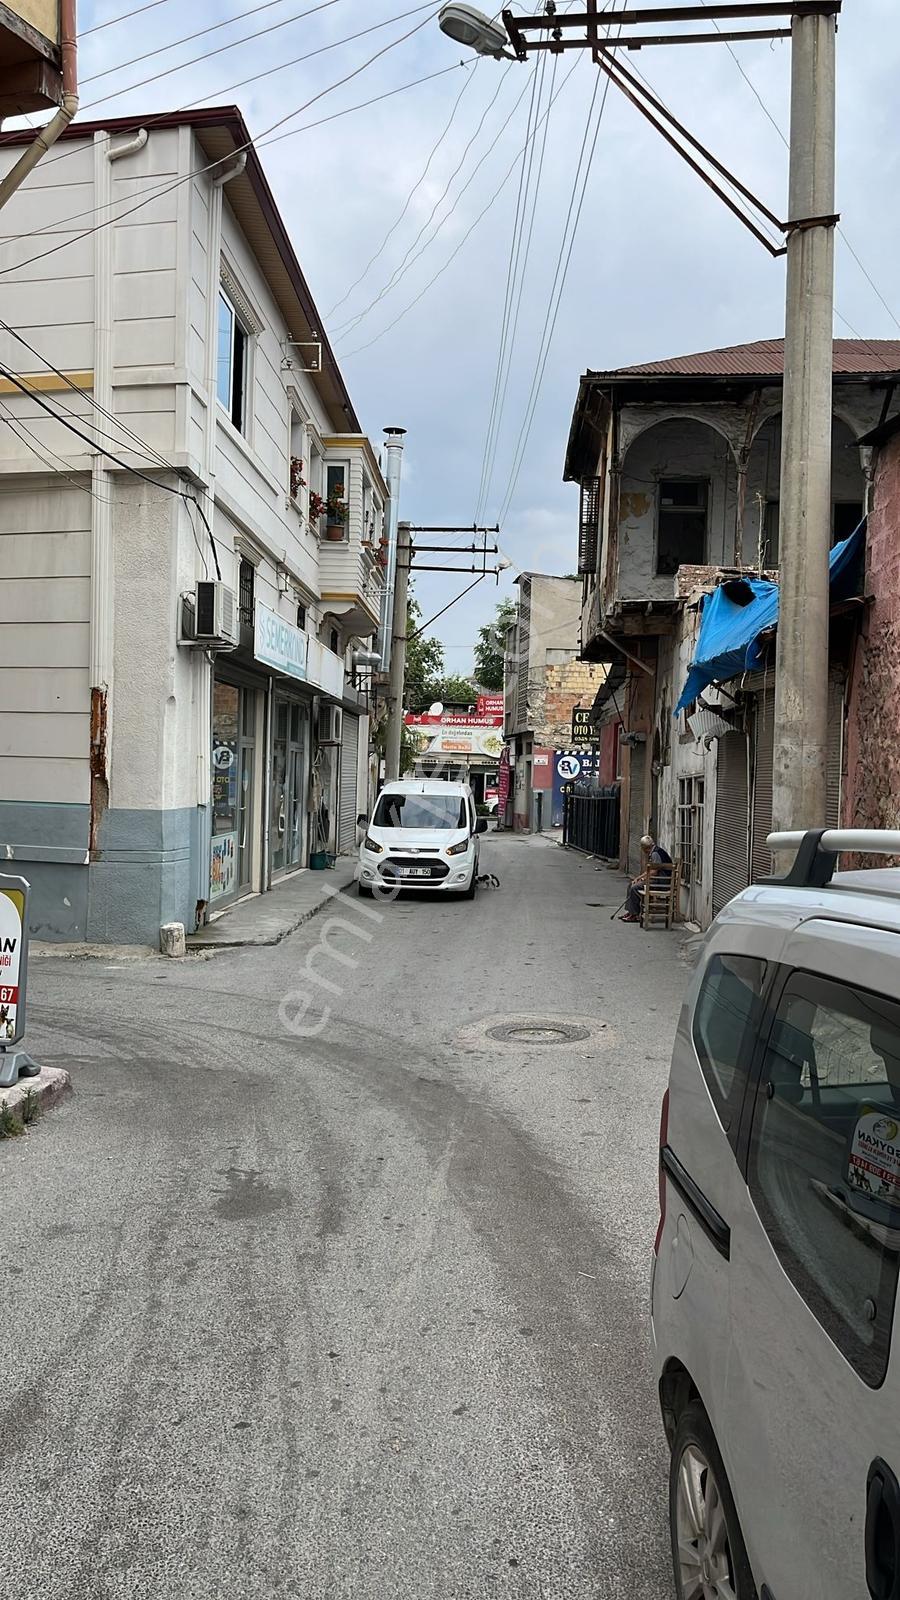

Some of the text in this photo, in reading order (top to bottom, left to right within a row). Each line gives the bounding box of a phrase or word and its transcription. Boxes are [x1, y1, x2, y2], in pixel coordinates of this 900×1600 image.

[574, 725, 588, 735] OTO
[0, 938, 16, 953] N
[1, 988, 14, 1002] 67
